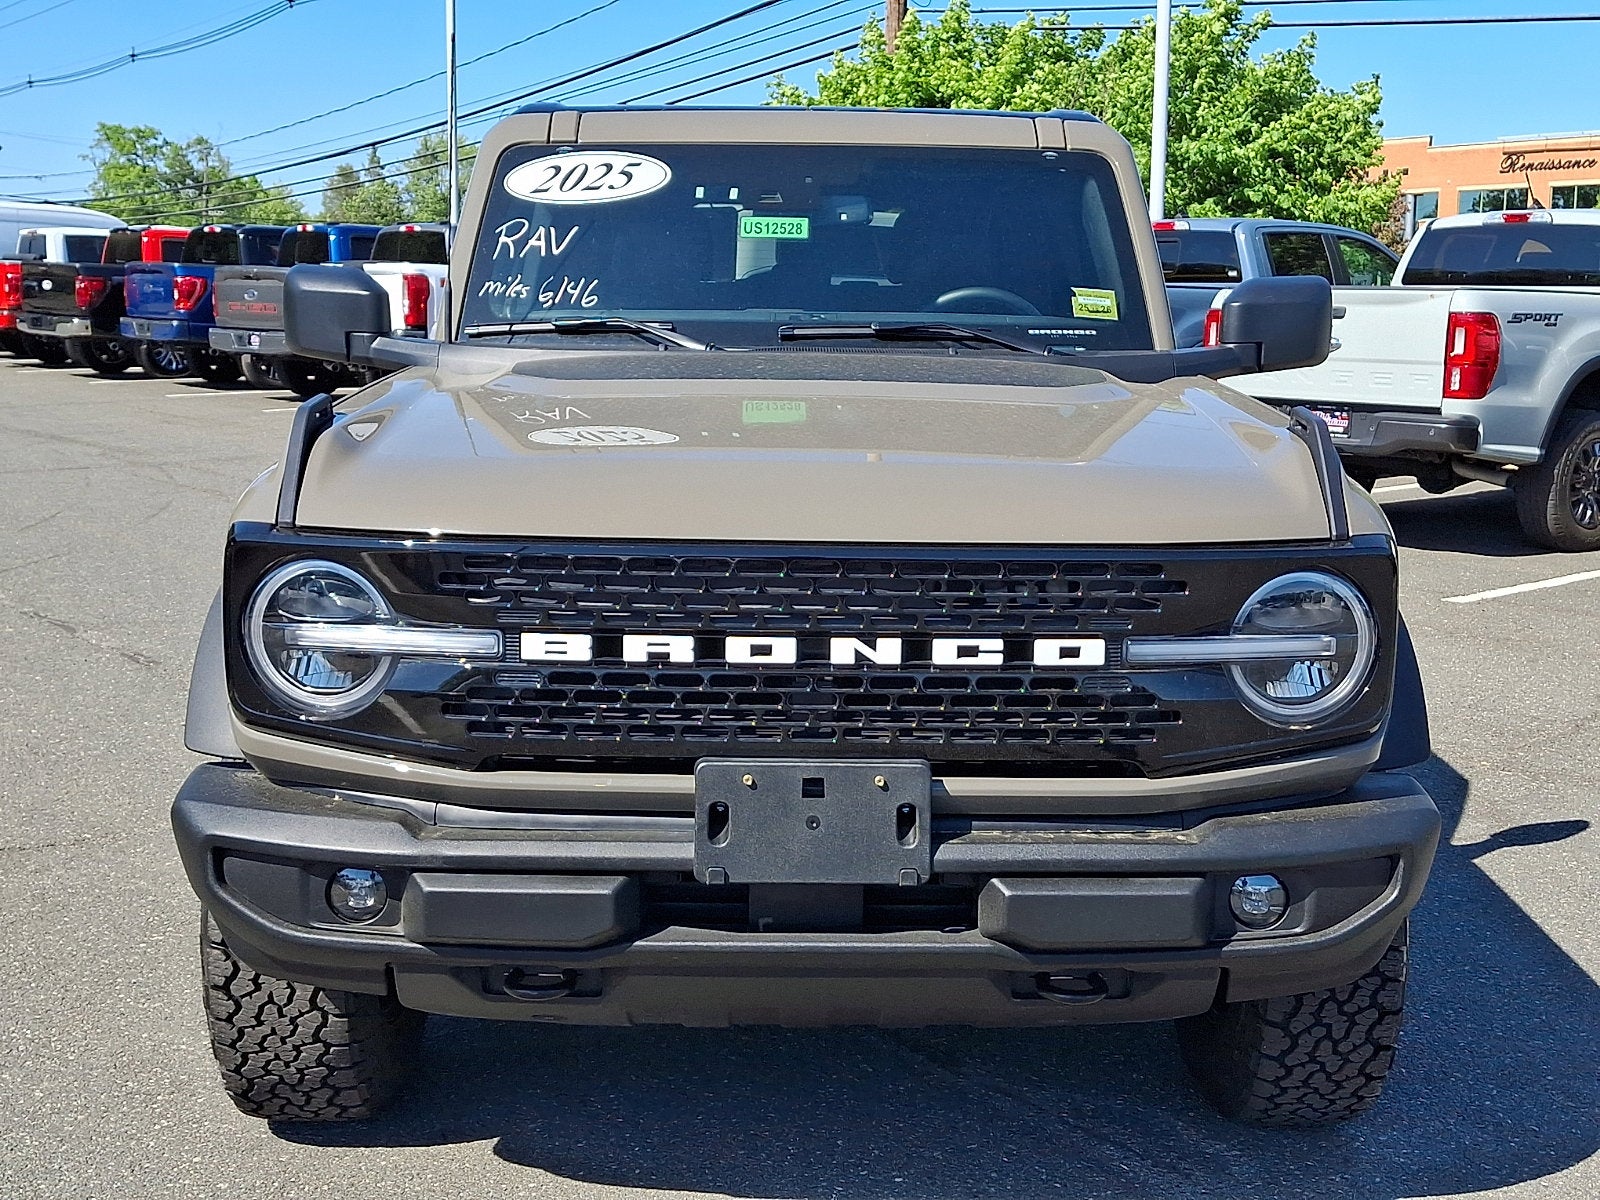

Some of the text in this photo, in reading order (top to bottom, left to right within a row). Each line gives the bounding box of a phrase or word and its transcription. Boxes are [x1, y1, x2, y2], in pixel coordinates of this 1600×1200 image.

[1500, 154, 1598, 174] Renaissance
[530, 162, 642, 193] 2025
[493, 218, 579, 260] RAV
[743, 223, 803, 235] US12528
[478, 274, 531, 299] miles
[1506, 312, 1564, 324] SPORT
[519, 631, 1108, 666] BRONCO
